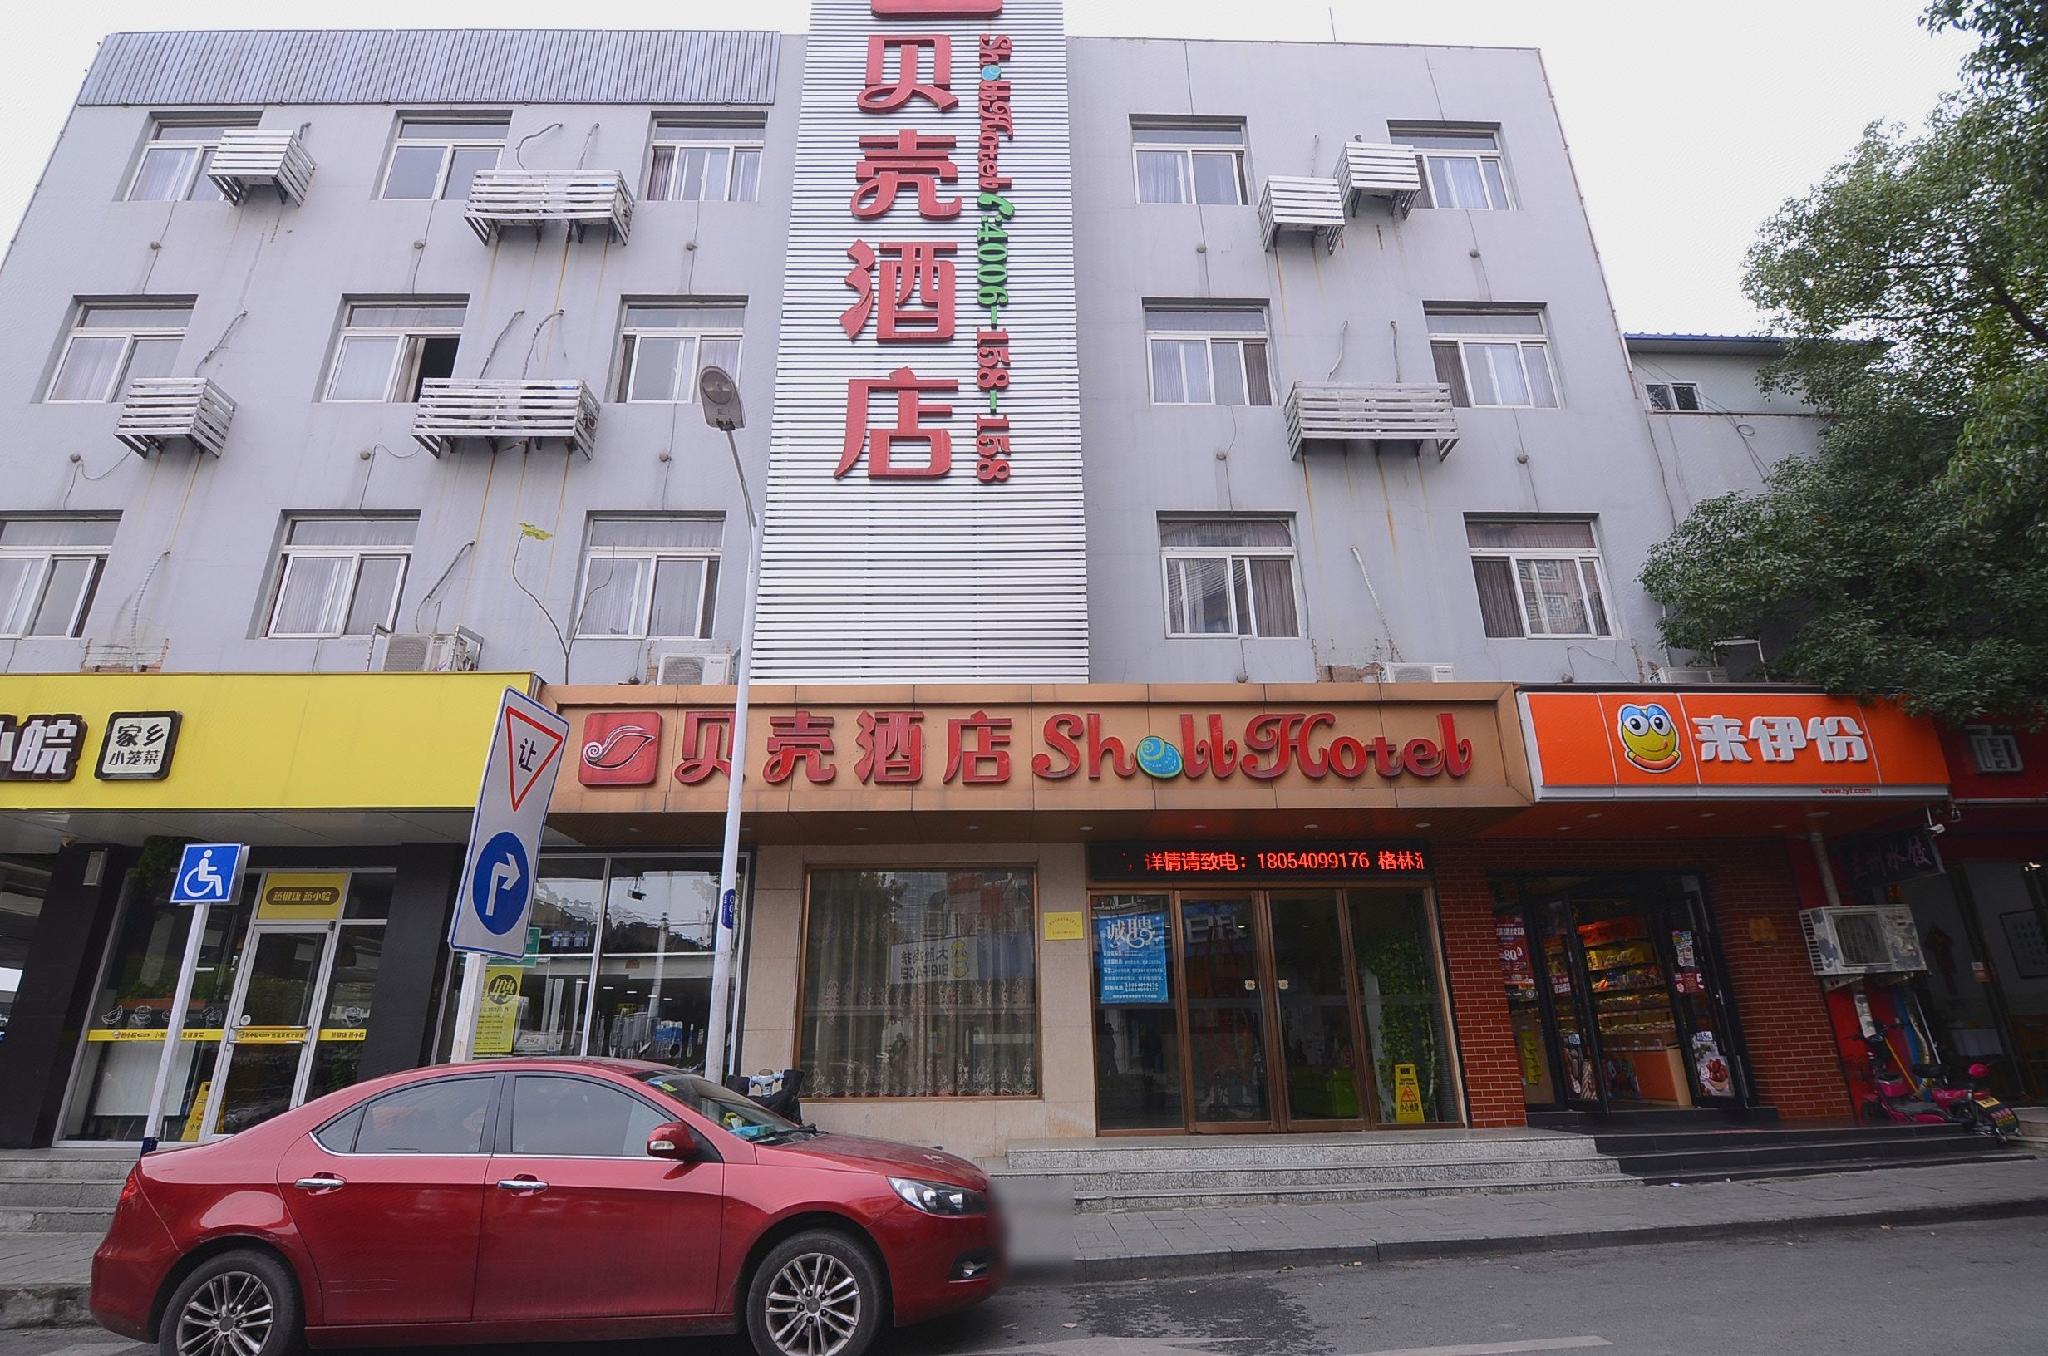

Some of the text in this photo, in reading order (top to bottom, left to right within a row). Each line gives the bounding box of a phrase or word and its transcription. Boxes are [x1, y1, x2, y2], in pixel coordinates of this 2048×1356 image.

[834, 34, 962, 480] 贝壳酒店
[115, 723, 166, 748] 家乡
[673, 710, 1012, 786] 贝壳酒店
[1690, 714, 1870, 763] 来伊份
[108, 749, 161, 765] 小笼菜
[518, 737, 537, 773] 让
[1256, 852, 1370, 869] 18054099176
[1103, 915, 1156, 949] 诚聘
